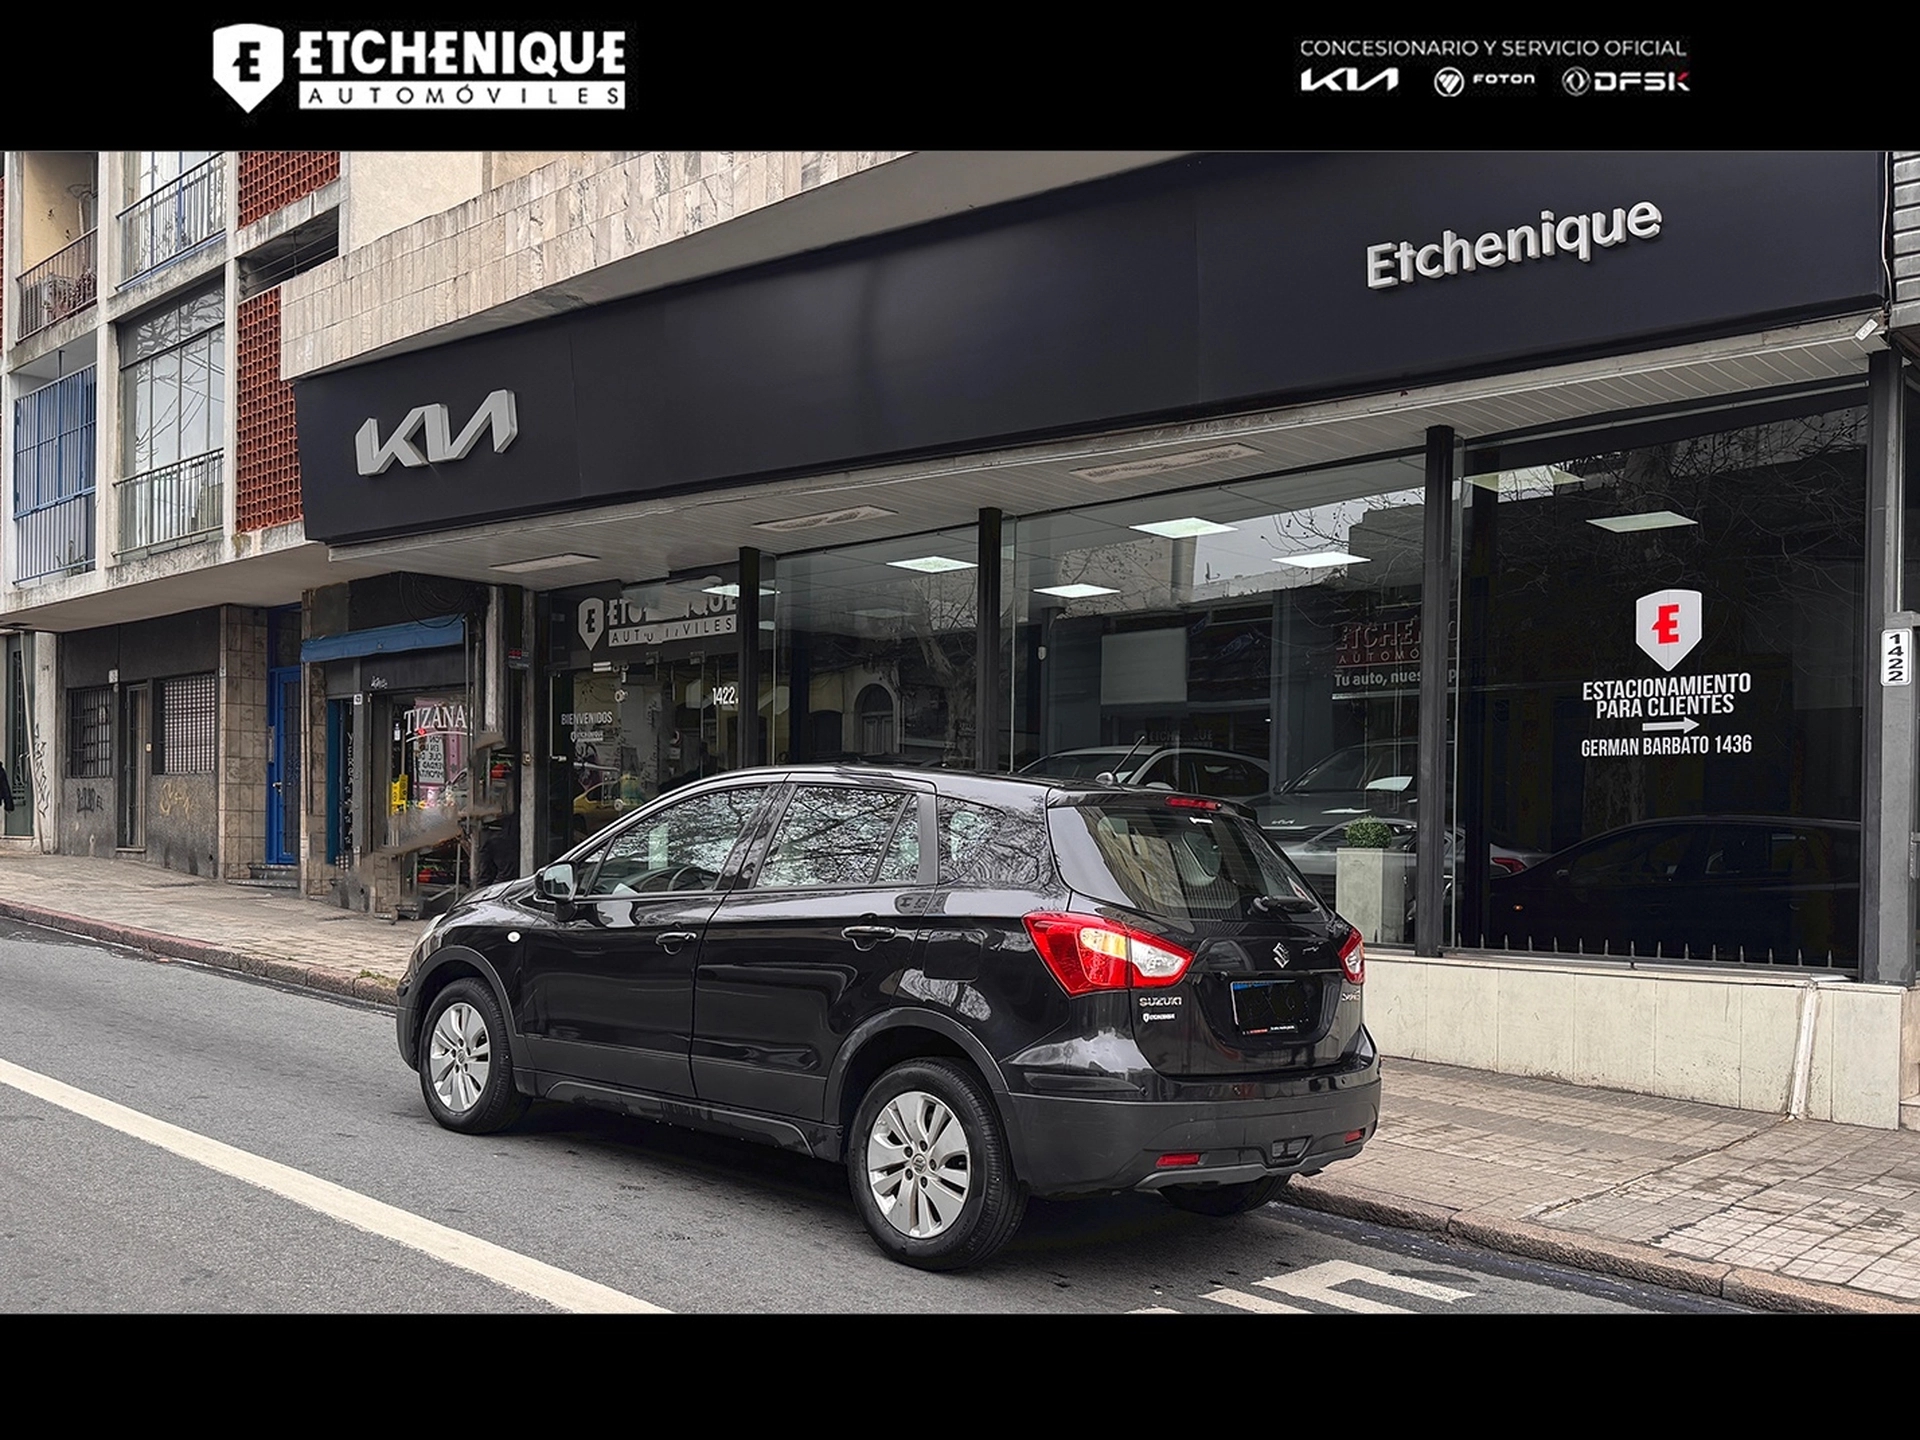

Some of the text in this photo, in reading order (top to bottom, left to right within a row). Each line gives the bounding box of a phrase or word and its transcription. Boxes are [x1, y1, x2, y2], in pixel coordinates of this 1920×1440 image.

[1367, 201, 1662, 289] Etchenique
[1888, 632, 1905, 683] 1422
[1334, 673, 1351, 687] Tu
[1352, 671, 1388, 687] auto,
[1582, 672, 1751, 701] ESTACIONAMIENTO
[1596, 694, 1735, 719] PARA CLIENTES
[1581, 734, 1752, 757] GERMAN BARBATO 1436
[1139, 996, 1182, 1007] SUZUKI
